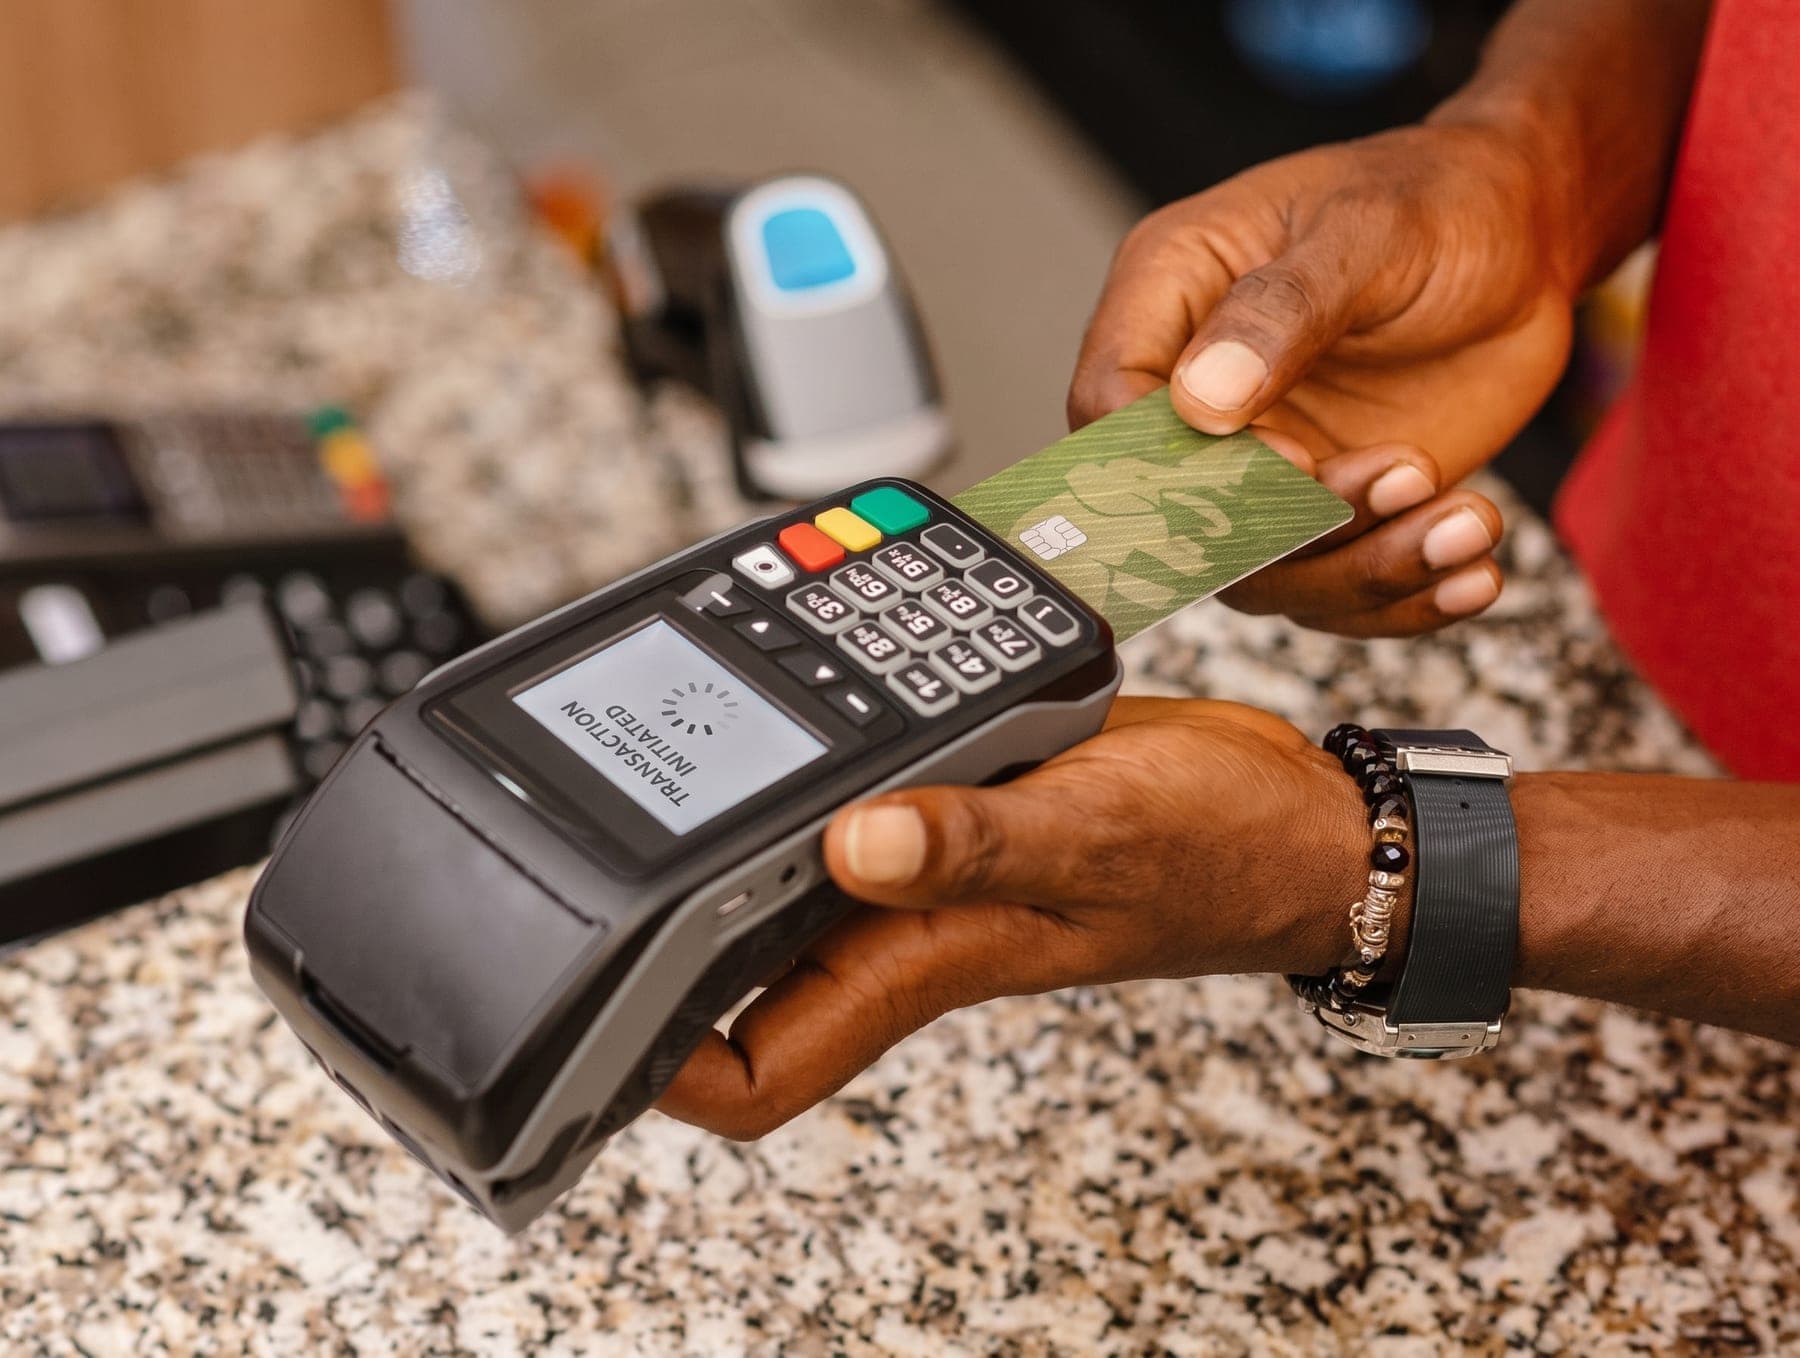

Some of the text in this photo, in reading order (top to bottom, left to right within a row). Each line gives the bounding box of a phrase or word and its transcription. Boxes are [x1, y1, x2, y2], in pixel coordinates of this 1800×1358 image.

[902, 559, 929, 578] 9
[861, 579, 888, 598] 6
[993, 577, 1019, 593] 0
[817, 597, 845, 619] 3
[950, 595, 977, 613] 8
[907, 616, 935, 636] 5
[1001, 637, 1028, 655] 7
[957, 655, 986, 675] 4
[916, 679, 942, 698] 1
[606, 705, 697, 777] INITIATED
[561, 700, 690, 807] TRANSACTION
